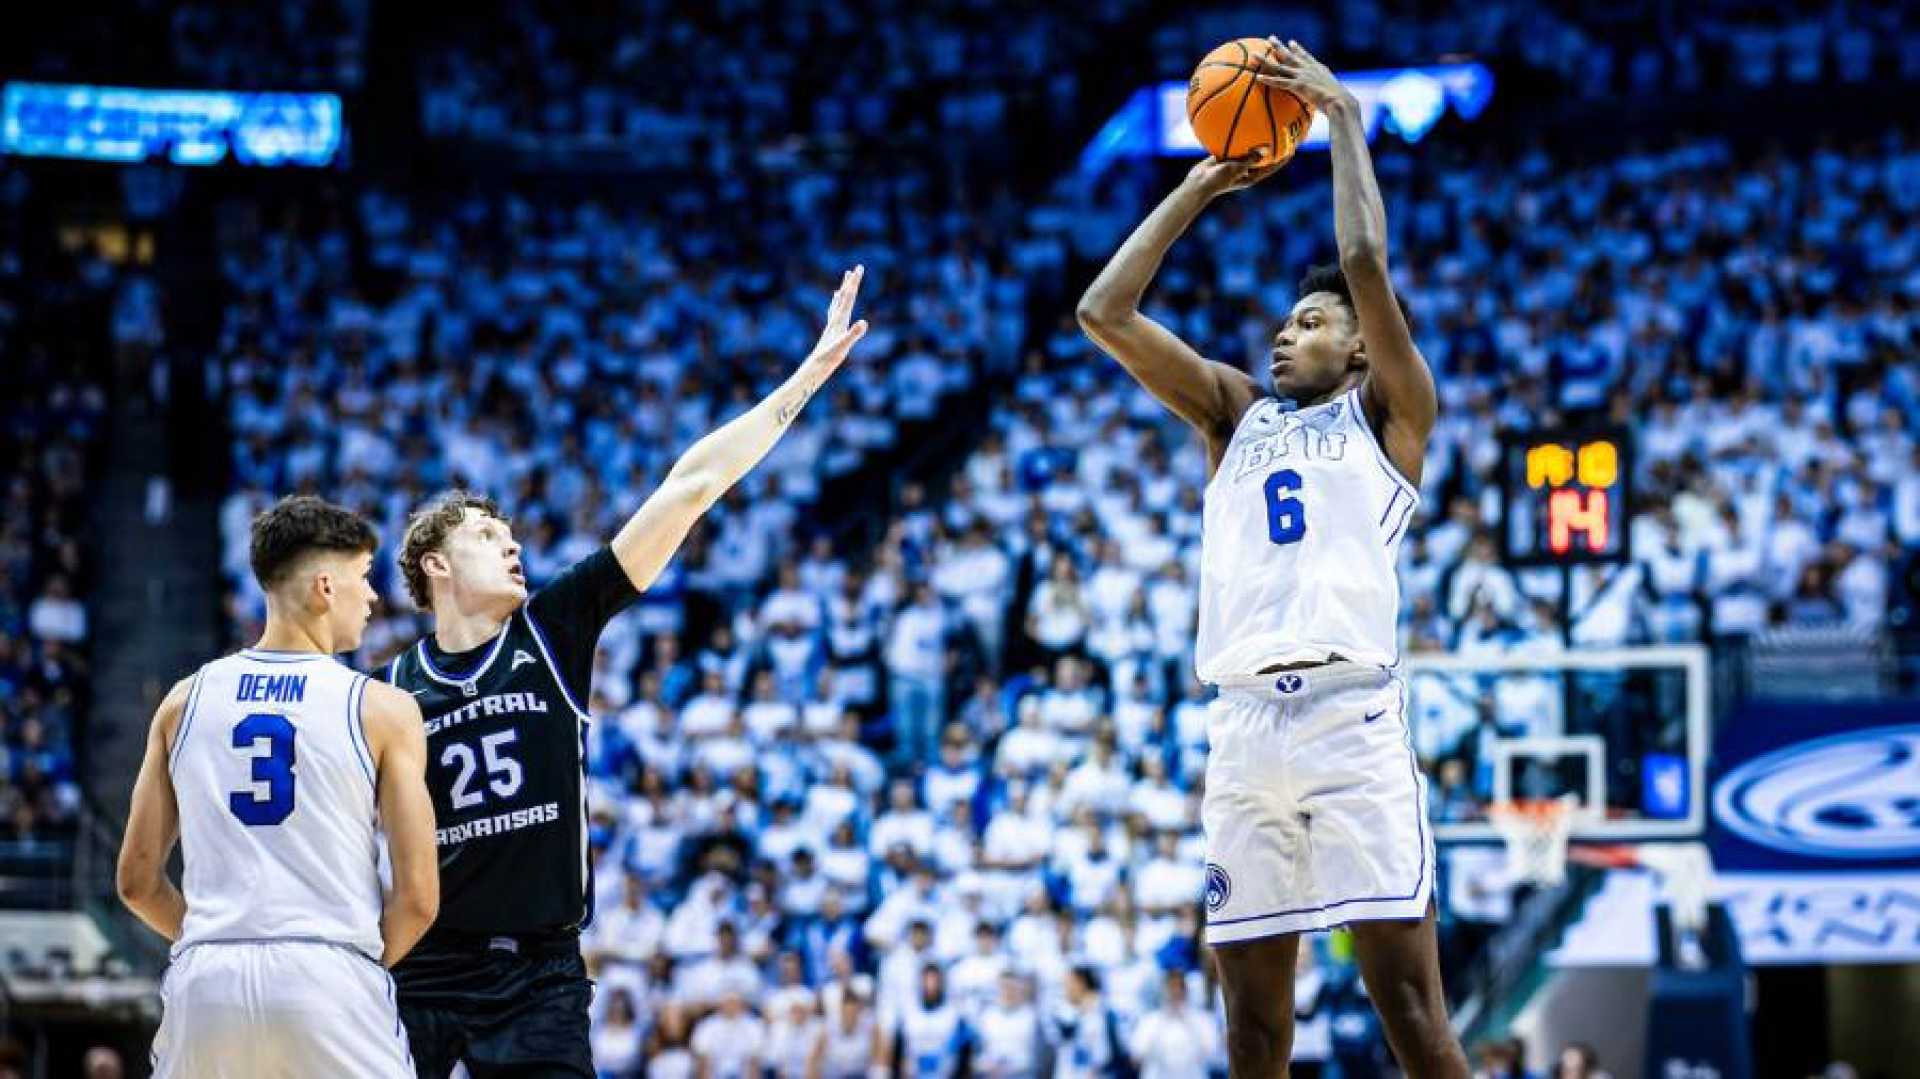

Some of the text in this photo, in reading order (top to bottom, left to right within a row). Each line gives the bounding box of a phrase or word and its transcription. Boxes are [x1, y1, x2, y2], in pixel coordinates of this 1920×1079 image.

[1235, 416, 1346, 482] BYU
[1264, 469, 1306, 544] 6
[1550, 488, 1607, 553] 14
[237, 673, 307, 702] DEMIN
[424, 692, 548, 736] ENTRAL
[230, 714, 297, 826] 3
[441, 729, 523, 811] 25
